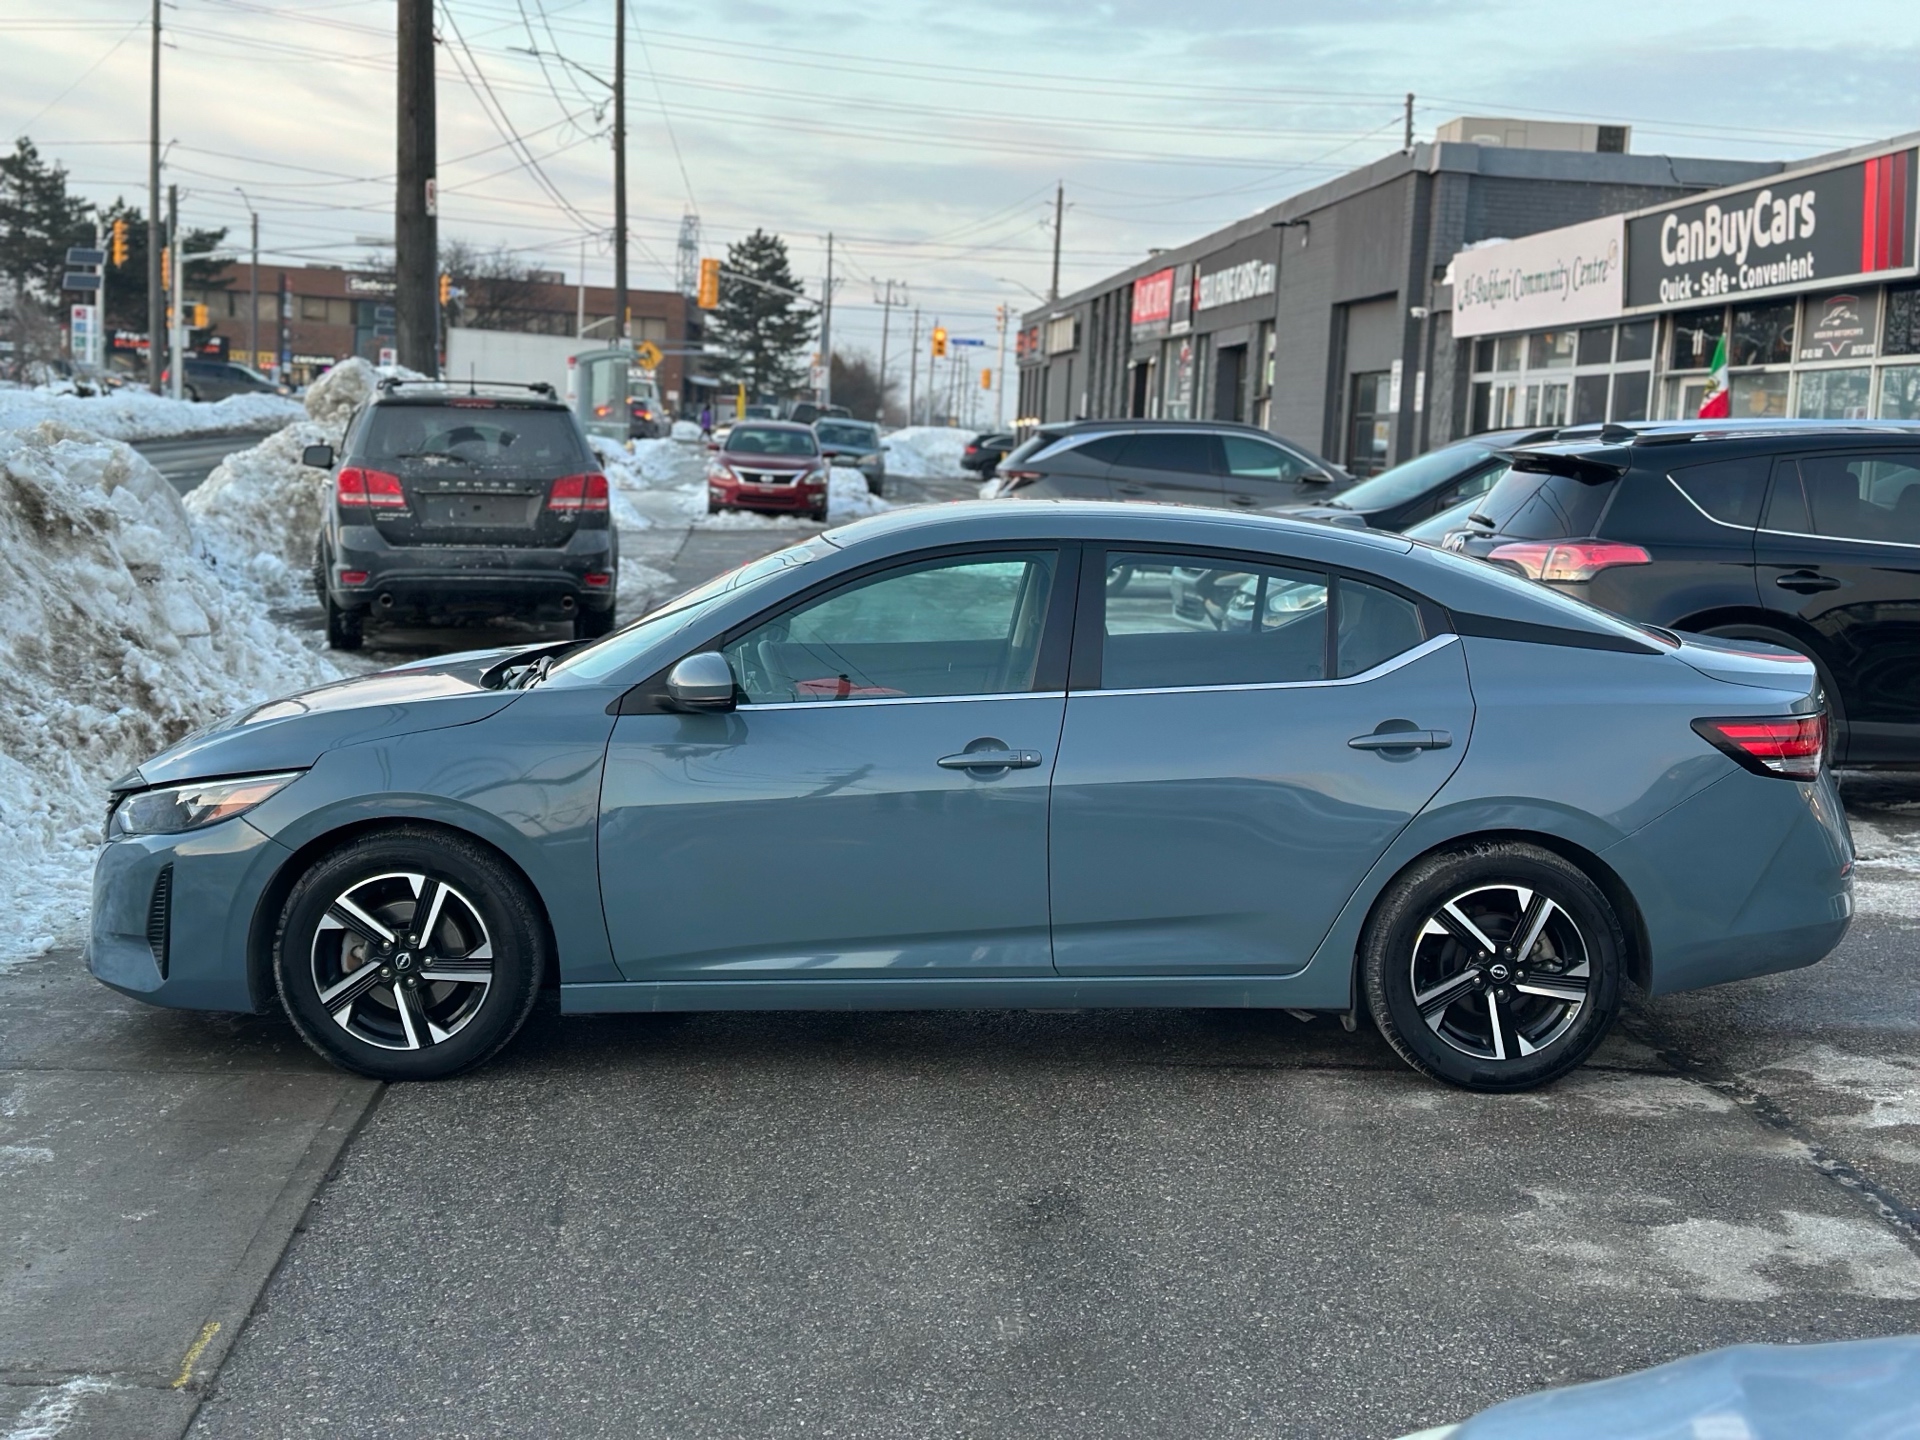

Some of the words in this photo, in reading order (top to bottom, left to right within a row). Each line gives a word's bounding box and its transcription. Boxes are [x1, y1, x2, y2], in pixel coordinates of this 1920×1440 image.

[1660, 190, 1816, 266] CanBuyCars
[1513, 258, 1570, 302] Community
[1572, 256, 1610, 292] Centre
[1660, 273, 1692, 304] Quick
[1701, 267, 1729, 297] Safe
[1739, 251, 1814, 290] Convenient
